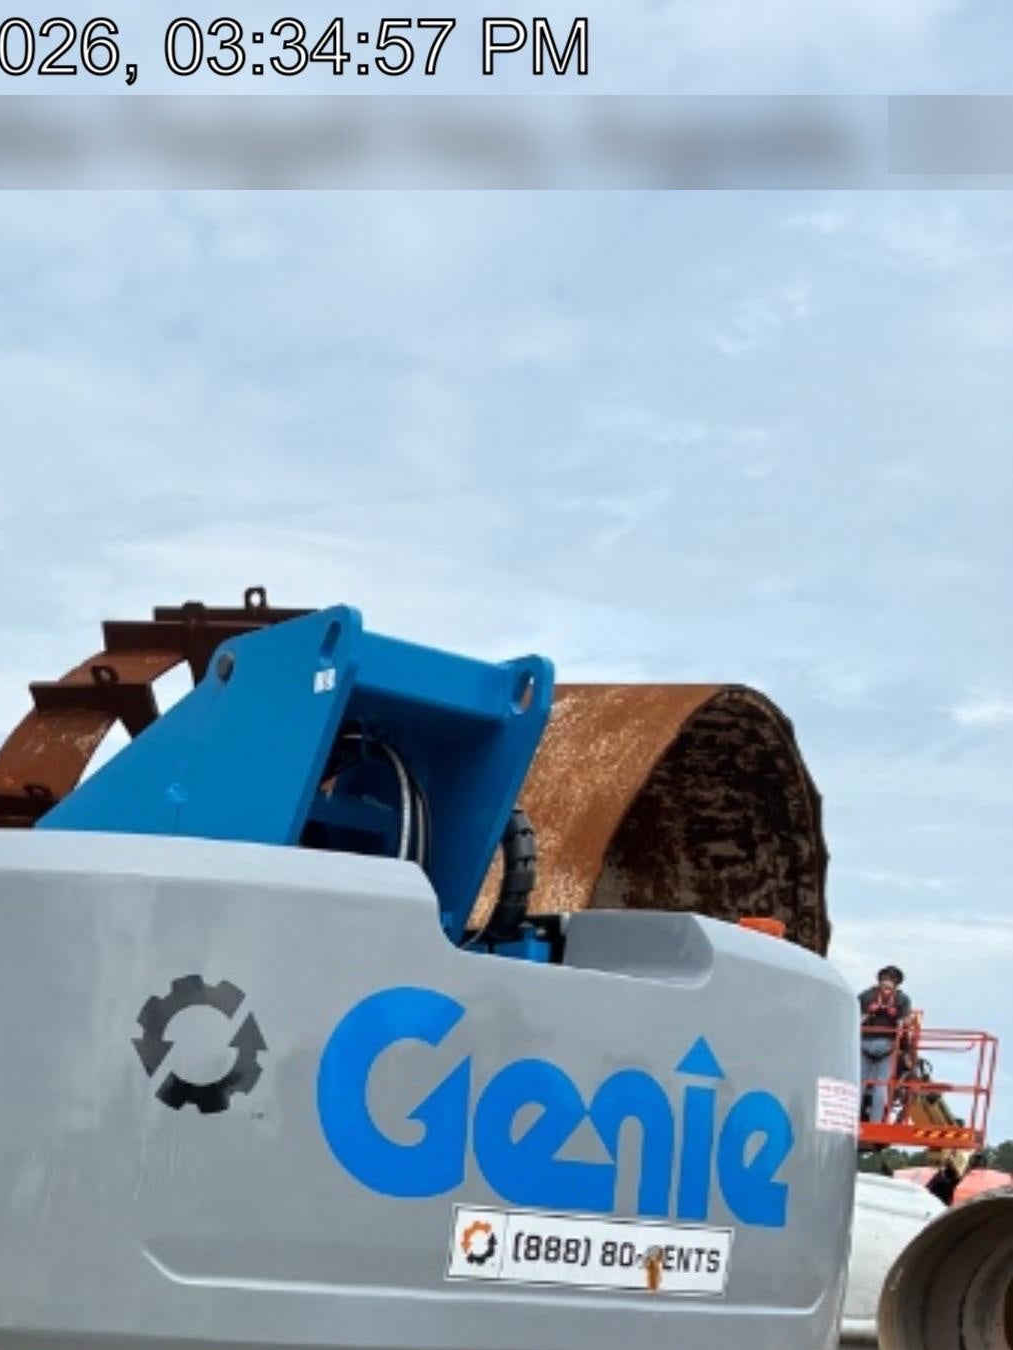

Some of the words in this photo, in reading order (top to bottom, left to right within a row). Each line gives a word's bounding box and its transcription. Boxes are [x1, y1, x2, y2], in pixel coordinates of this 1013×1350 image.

[317, 986, 795, 1227] Genie
[511, 1231, 592, 1267] (888)
[600, 1240, 721, 1273] 80-ENTS
